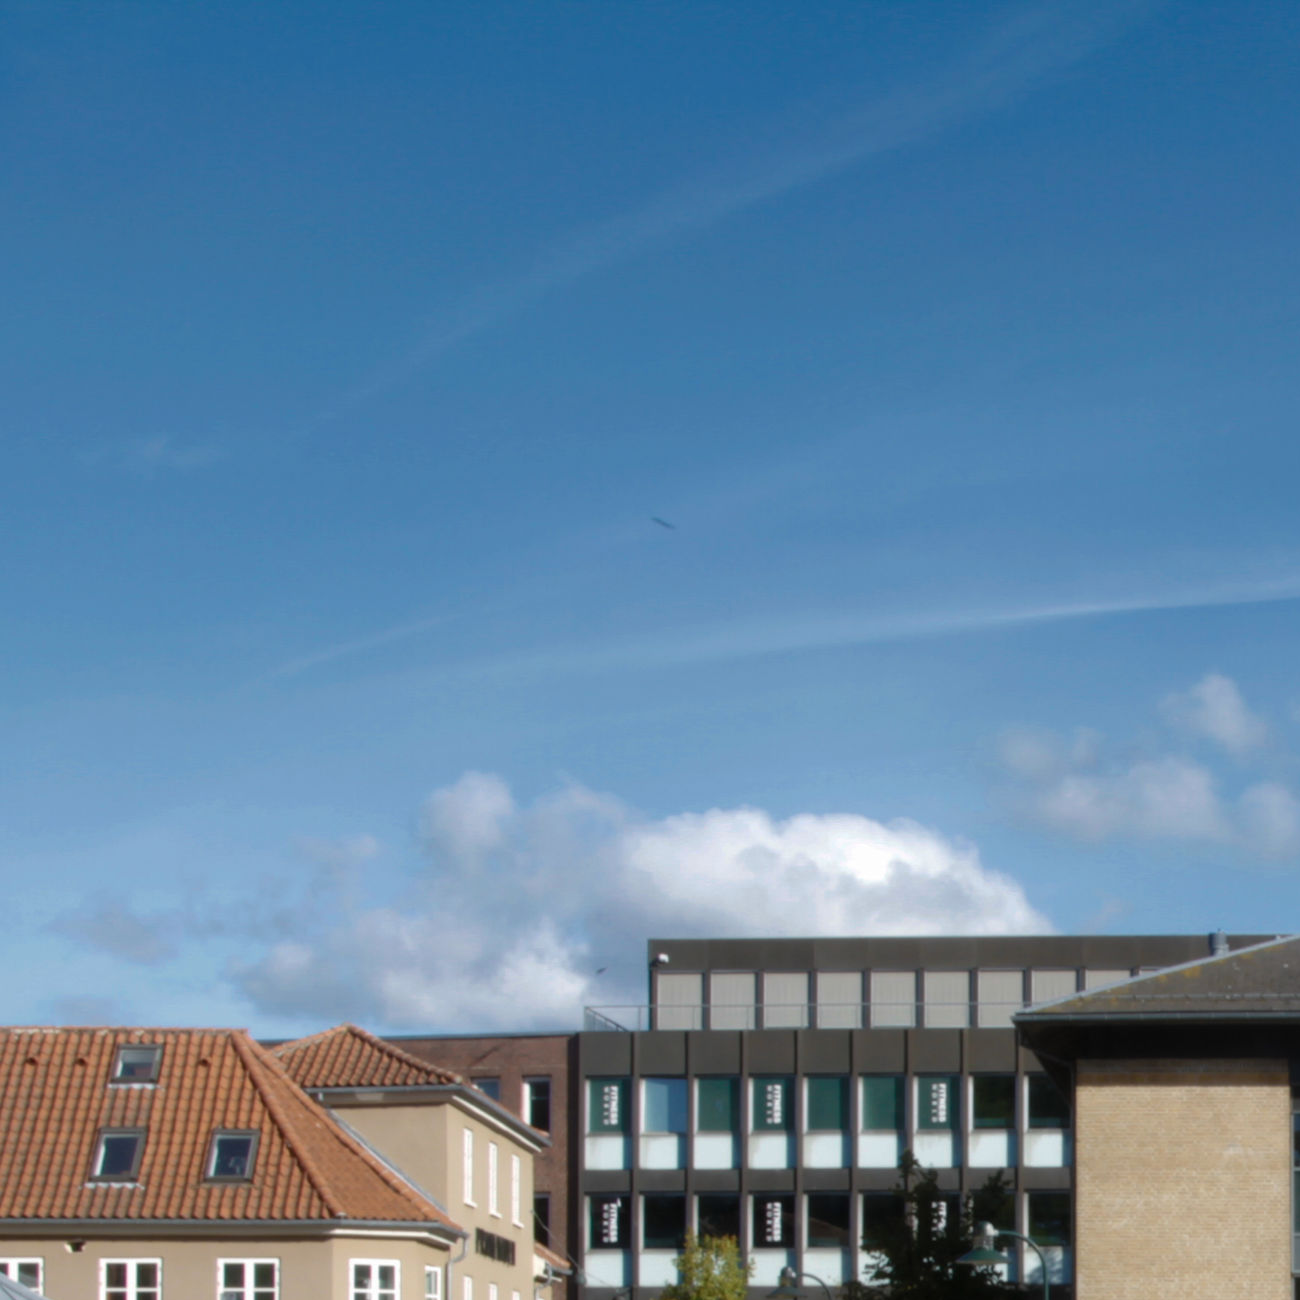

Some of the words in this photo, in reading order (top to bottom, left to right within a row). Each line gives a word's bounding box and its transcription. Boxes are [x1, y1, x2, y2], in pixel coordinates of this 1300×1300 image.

[610, 1086, 618, 1125] FITNESS
[773, 1084, 781, 1123] FITNESS
[938, 1083, 946, 1122] FITNESS
[610, 1203, 618, 1243] FITNESS
[773, 1202, 781, 1241] FITNESS
